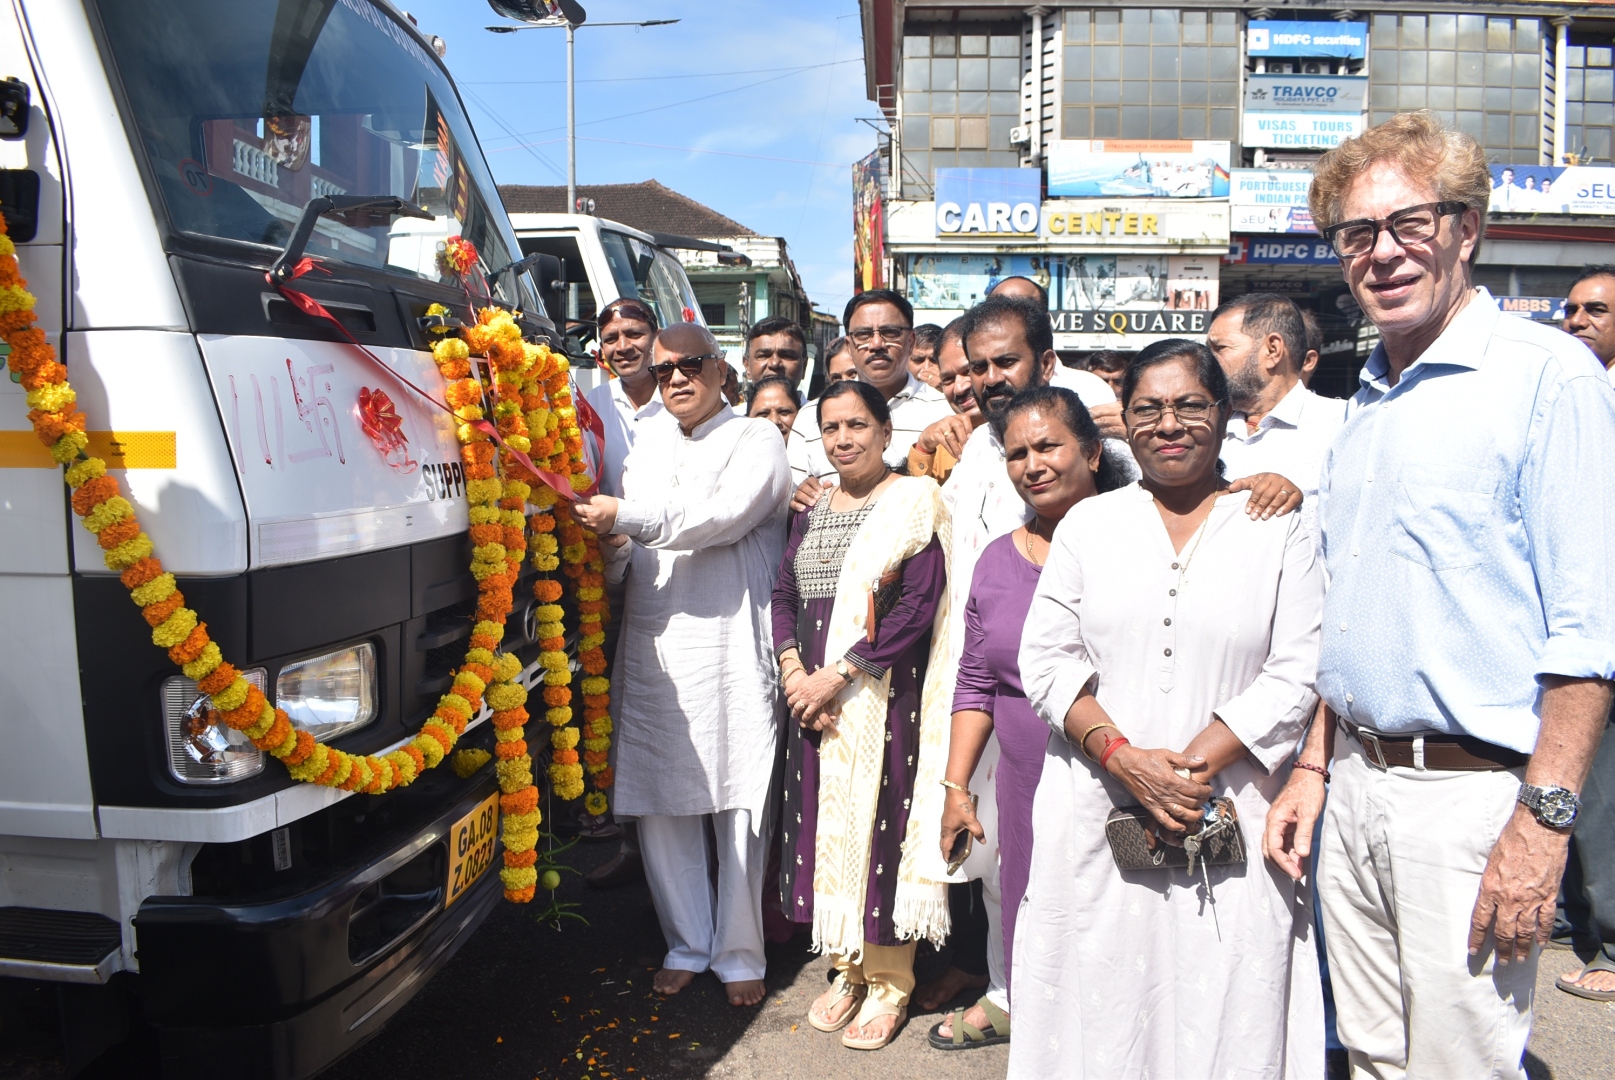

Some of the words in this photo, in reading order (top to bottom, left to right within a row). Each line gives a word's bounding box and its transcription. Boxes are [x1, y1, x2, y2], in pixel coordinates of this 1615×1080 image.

[1273, 34, 1311, 45] HDFC
[1313, 34, 1361, 46] securities
[1272, 86, 1337, 97] TRAVCO
[1258, 120, 1297, 131] VISAS
[1312, 121, 1353, 132] TOURS
[1272, 133, 1338, 145] TICKETING
[1240, 181, 1307, 192] PORTUGUESE
[1255, 194, 1291, 203] INDIAN
[936, 202, 1039, 233] CARO
[1049, 213, 1158, 235] CENTER
[1240, 215, 1266, 224] SEU
[1253, 244, 1309, 258] HDFC
[1503, 299, 1551, 312] MBBS
[1093, 312, 1205, 336] SQUARE
[458, 805, 493, 858] GA.08
[452, 836, 493, 898] Z.0823
